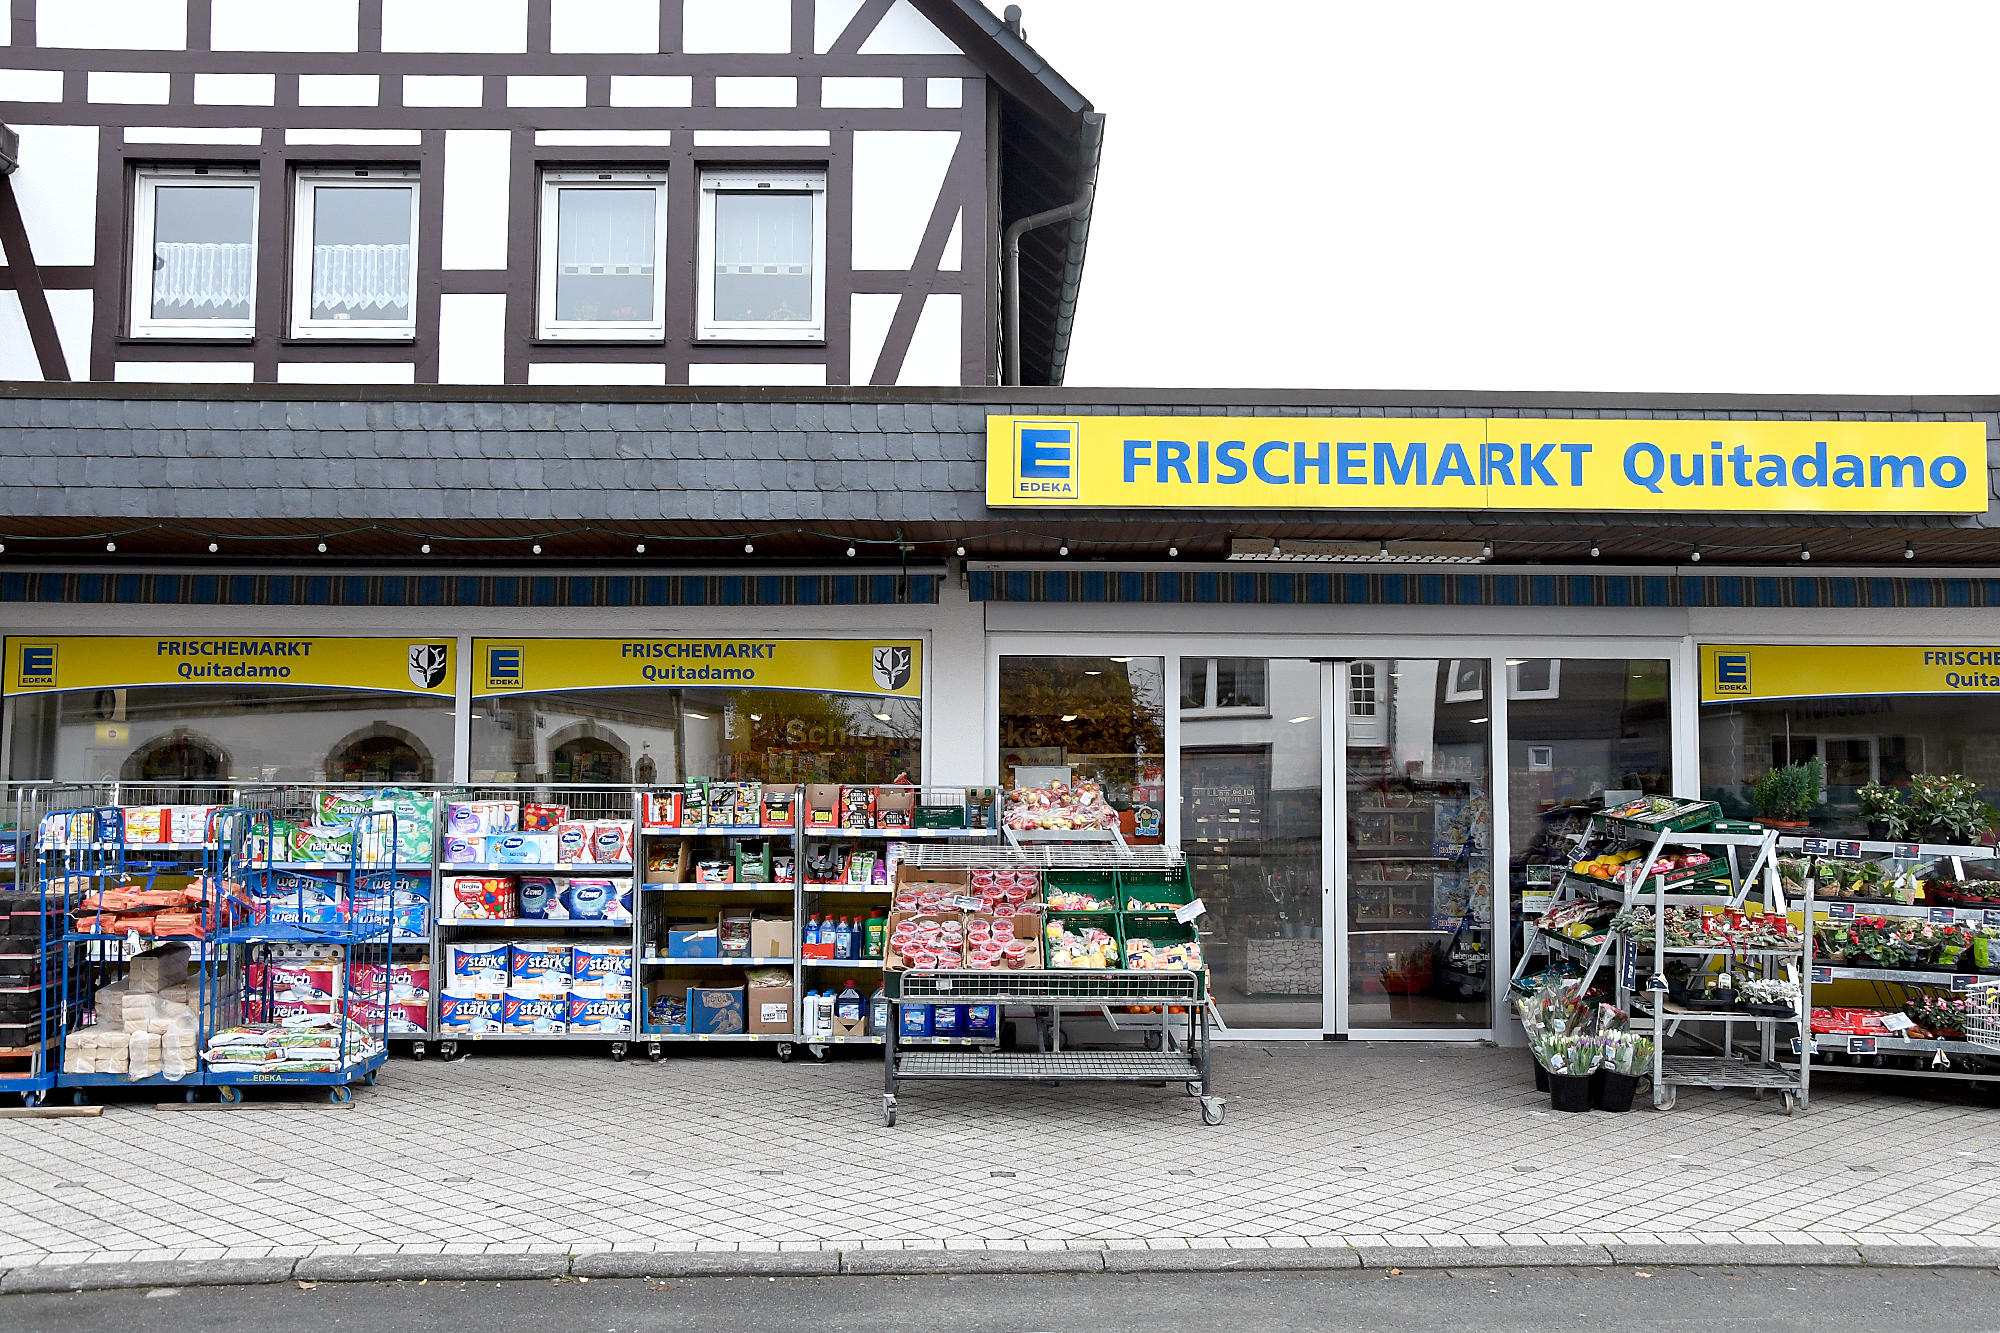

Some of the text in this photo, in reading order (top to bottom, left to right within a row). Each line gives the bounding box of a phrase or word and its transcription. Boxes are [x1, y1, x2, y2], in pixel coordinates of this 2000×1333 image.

[1123, 439, 1967, 495] FRISCHEMARKT Quitadamo
[1020, 482, 1072, 492] EDEKA
[157, 641, 312, 657] FRISCHEMARKT
[621, 643, 777, 659] FRISCHEMARKT
[177, 662, 291, 680] Quitadamo
[641, 664, 755, 681] Quitadamo
[309, 842, 352, 852] natürlich
[524, 887, 542, 896] Zewa
[580, 890, 601, 899] Zewa
[468, 954, 498, 967] stark
[528, 954, 563, 968] stark
[589, 957, 624, 971] stark
[456, 1001, 491, 1016] stark
[520, 1001, 555, 1016] stark
[586, 1001, 622, 1016] stark
[253, 1074, 282, 1082] EDEKA
